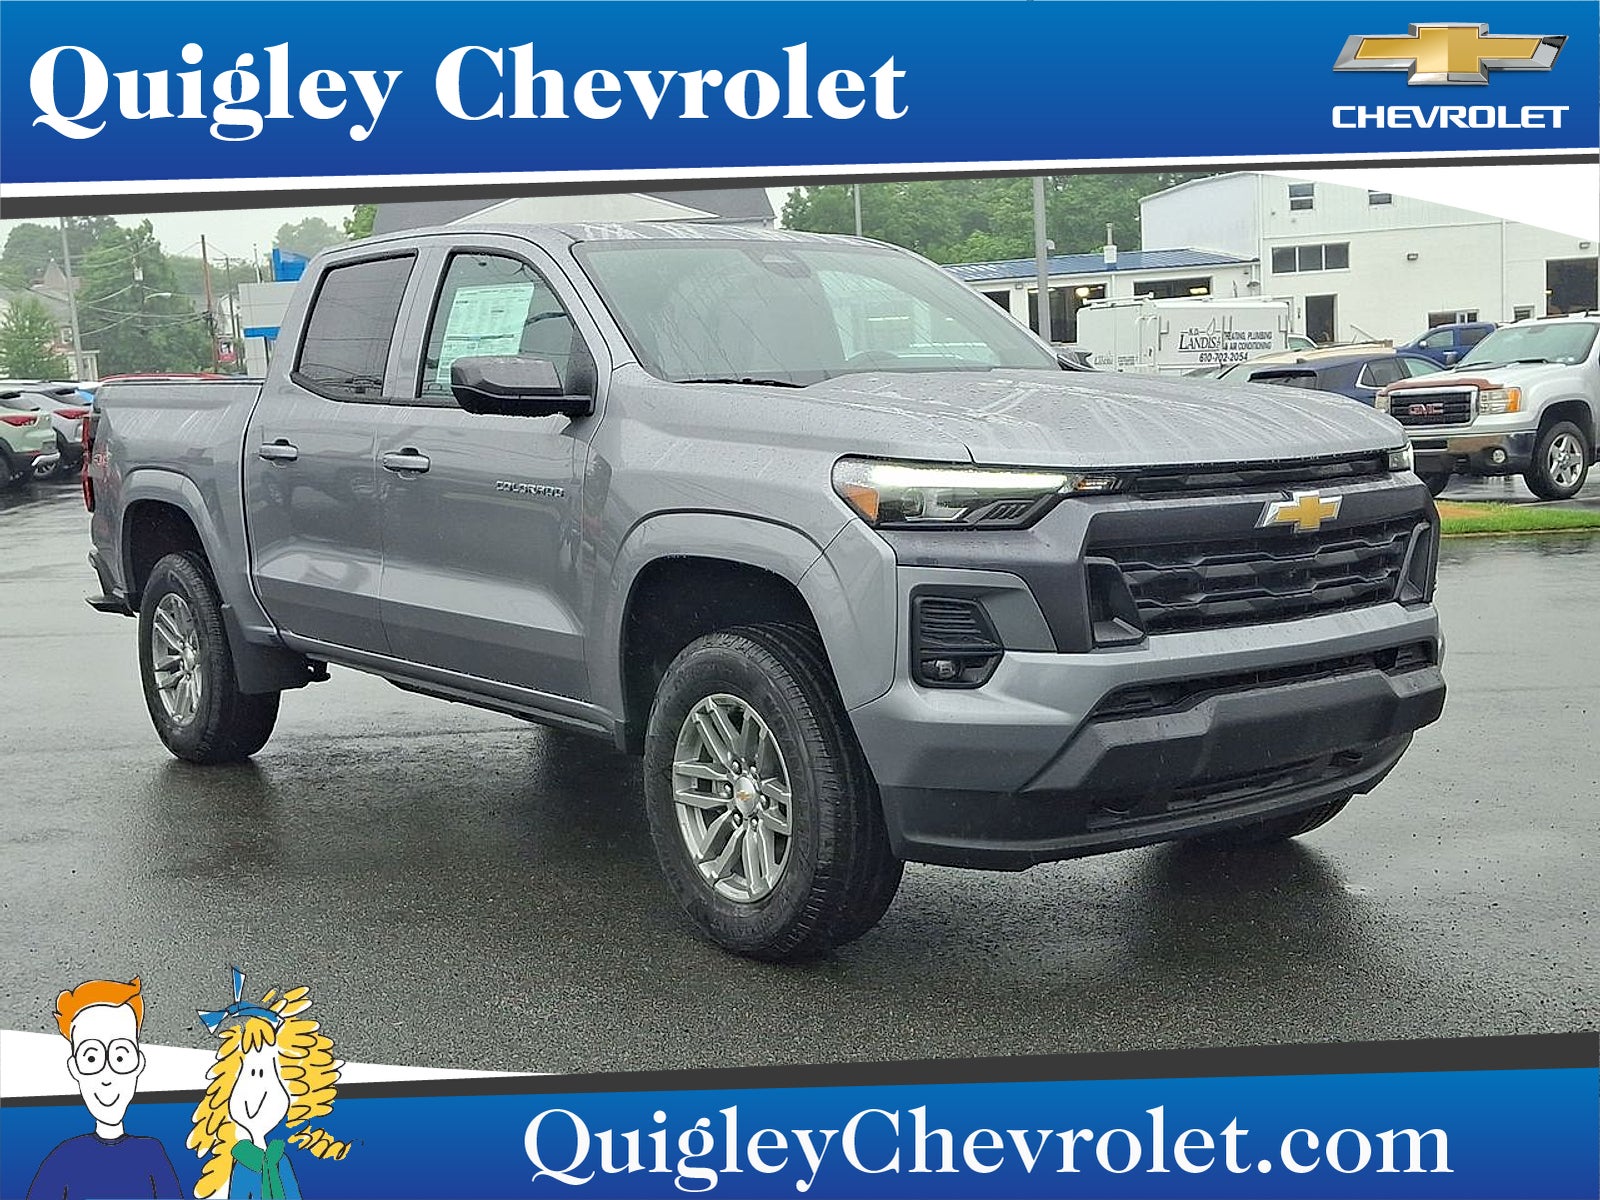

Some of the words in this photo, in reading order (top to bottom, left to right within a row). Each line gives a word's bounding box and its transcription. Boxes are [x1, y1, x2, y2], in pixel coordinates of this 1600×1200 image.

[1199, 352, 1249, 363] 610-702-2054
[1408, 402, 1445, 417] GMC
[495, 480, 565, 498] COLORADO
